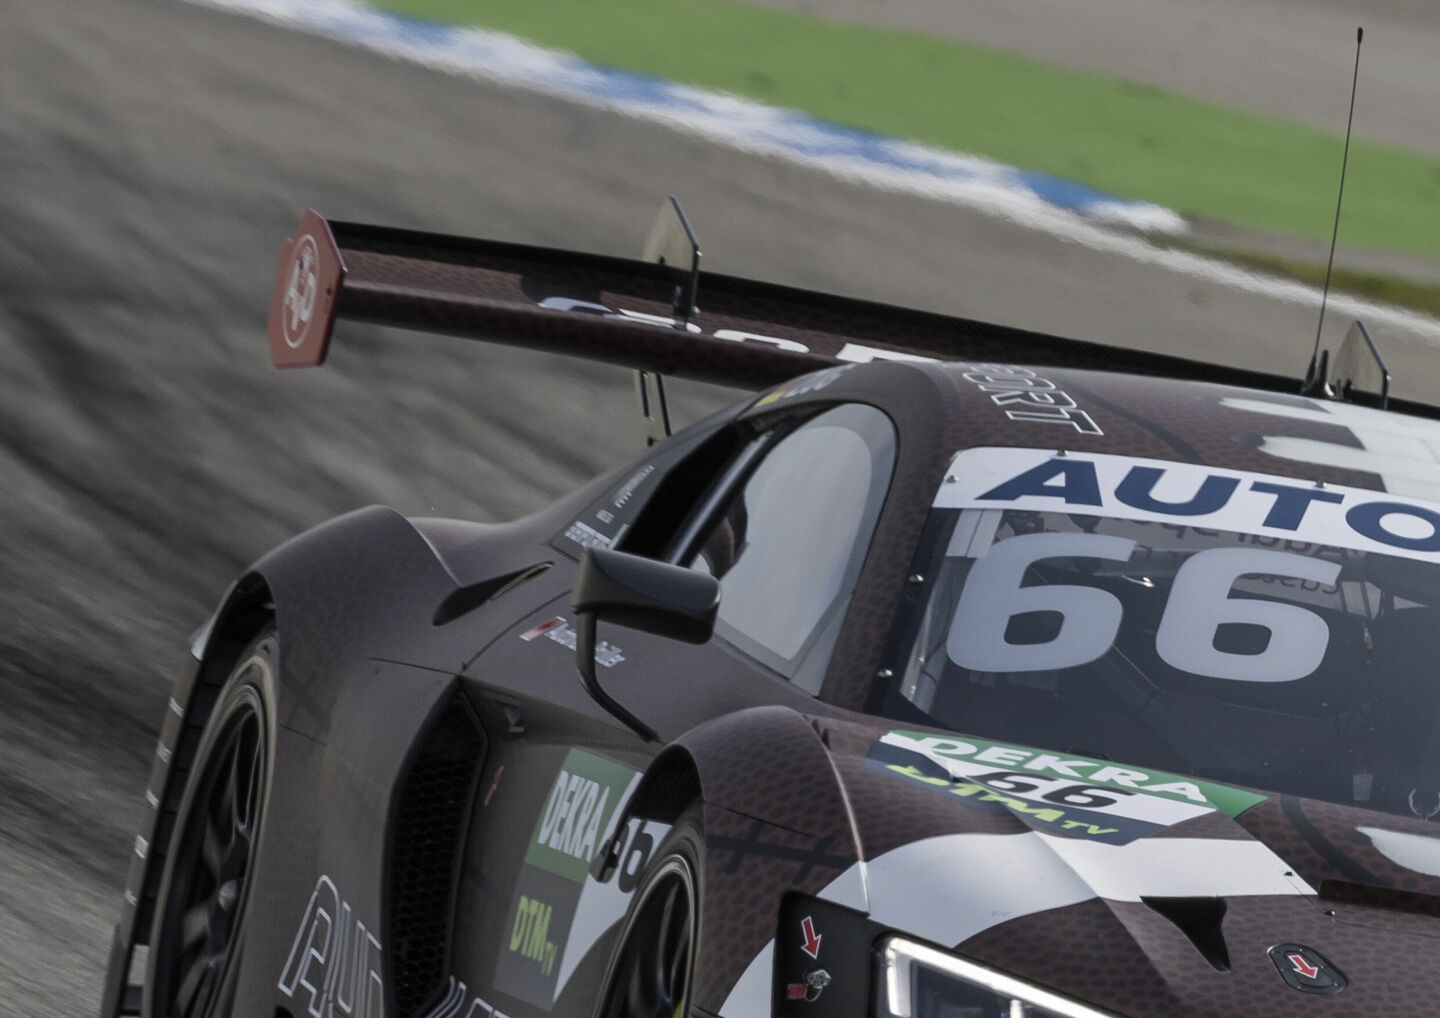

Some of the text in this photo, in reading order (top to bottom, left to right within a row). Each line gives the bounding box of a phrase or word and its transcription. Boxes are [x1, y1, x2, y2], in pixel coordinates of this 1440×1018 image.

[946, 532, 1343, 682] 66
[914, 736, 1207, 803] DEKRA
[537, 770, 611, 863] DEKRA
[510, 895, 552, 963] DTM
